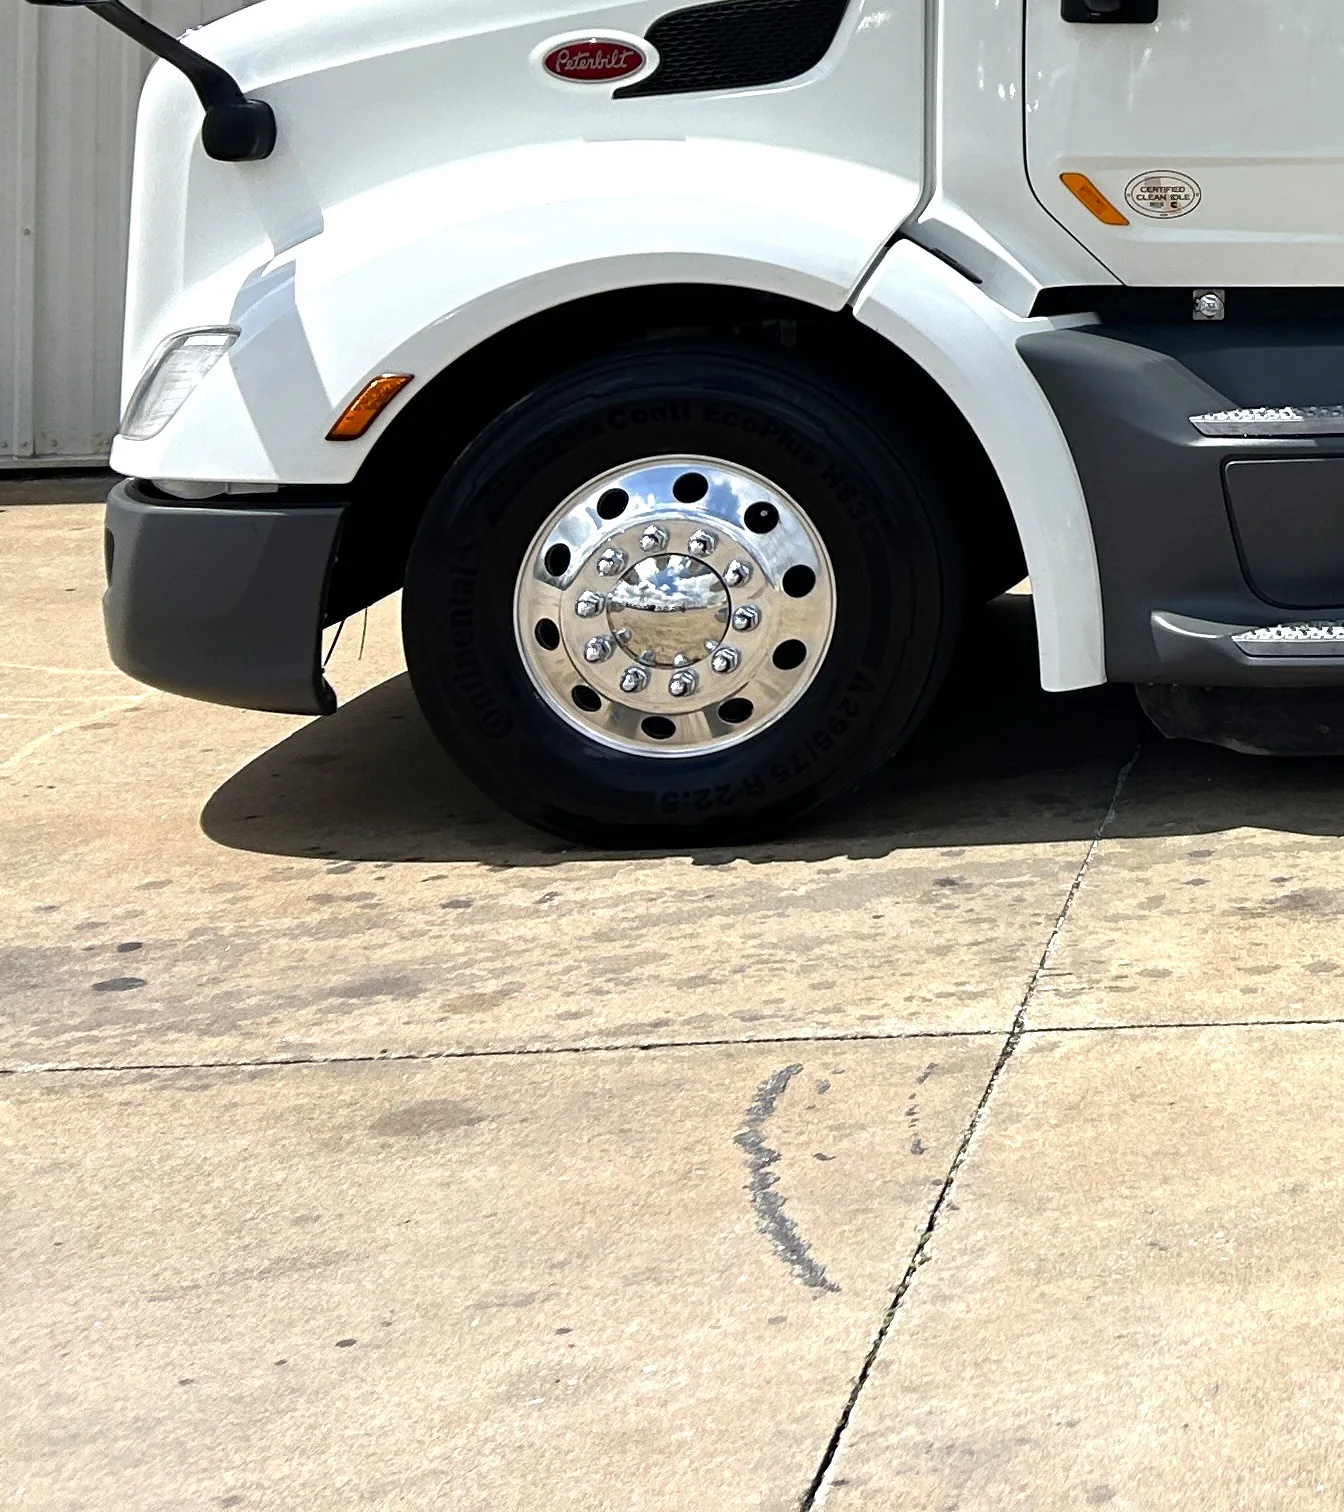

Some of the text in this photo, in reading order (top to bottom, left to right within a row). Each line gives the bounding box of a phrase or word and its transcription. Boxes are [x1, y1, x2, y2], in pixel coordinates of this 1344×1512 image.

[554, 49, 635, 73] Peterbilt
[605, 399, 691, 429] Conti
[702, 402, 820, 467] EcoPlus
